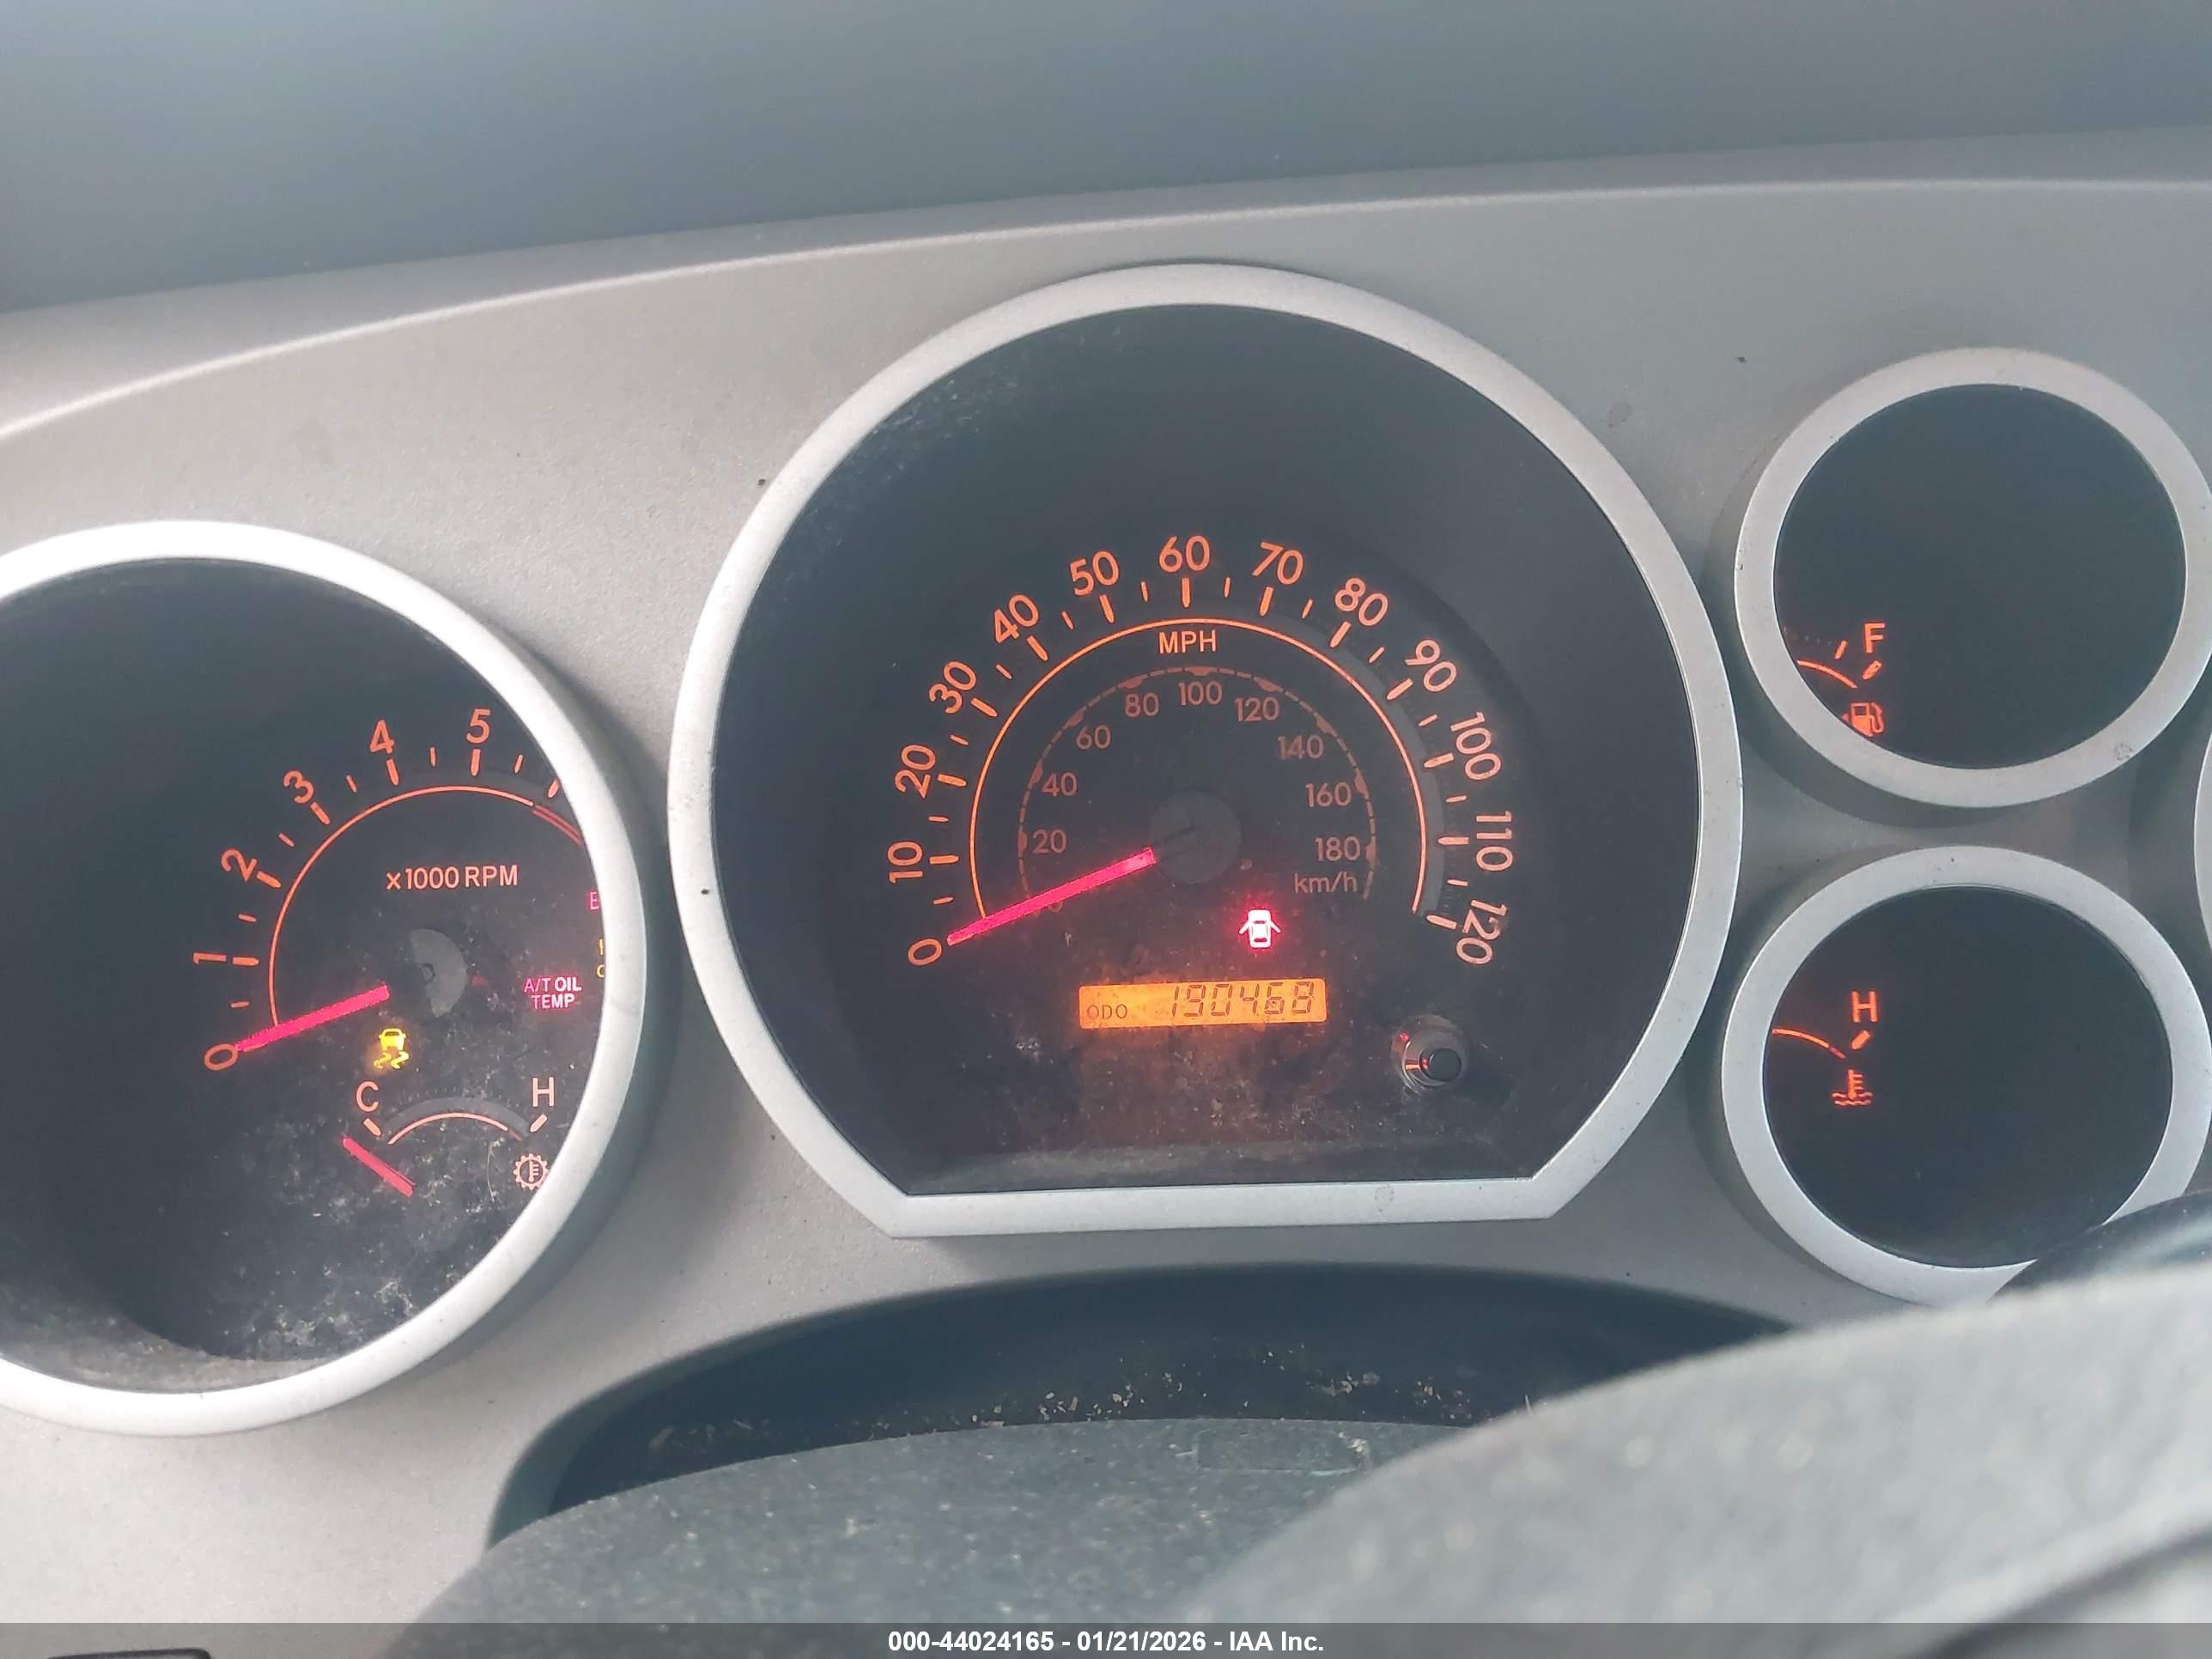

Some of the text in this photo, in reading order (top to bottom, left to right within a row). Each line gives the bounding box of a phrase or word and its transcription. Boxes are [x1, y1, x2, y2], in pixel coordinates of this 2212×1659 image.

[1158, 535, 1210, 573] 60
[1251, 542, 1304, 585] 70
[1069, 550, 1119, 597] 50
[1335, 577, 1389, 626] 80
[993, 594, 1040, 644] 40
[1159, 631, 1216, 654] MPH
[1863, 622, 1886, 653] F
[1404, 639, 1457, 693] 90
[928, 660, 976, 714] 30
[1178, 681, 1223, 707] 100
[1124, 692, 1160, 718] 80
[1235, 696, 1280, 723] 120
[370, 719, 394, 754] 4
[467, 708, 491, 743] 5
[1075, 724, 1111, 750] 60
[1277, 735, 1324, 761] 140
[1450, 711, 1502, 781] 100
[894, 744, 936, 799] 20
[1042, 773, 1078, 797] 40
[283, 770, 314, 804] 3
[1305, 782, 1352, 808] 160
[1033, 830, 1066, 854] 20
[1315, 836, 1361, 861] 180
[1475, 810, 1514, 872] 110
[221, 848, 257, 881] 2
[465, 865, 518, 887] RPM
[887, 841, 923, 883] 10
[1294, 871, 1358, 896] km/h
[1456, 899, 1508, 964] 120
[193, 952, 227, 964] 1
[907, 938, 942, 966] 0
[524, 976, 582, 993] A/T OIL
[531, 994, 575, 1009] TEMP
[1086, 981, 1315, 1020] ODO 190468
[1851, 990, 1879, 1023] H
[204, 1045, 238, 1070] 0
[356, 1081, 379, 1111] C
[532, 1077, 554, 1107] H
